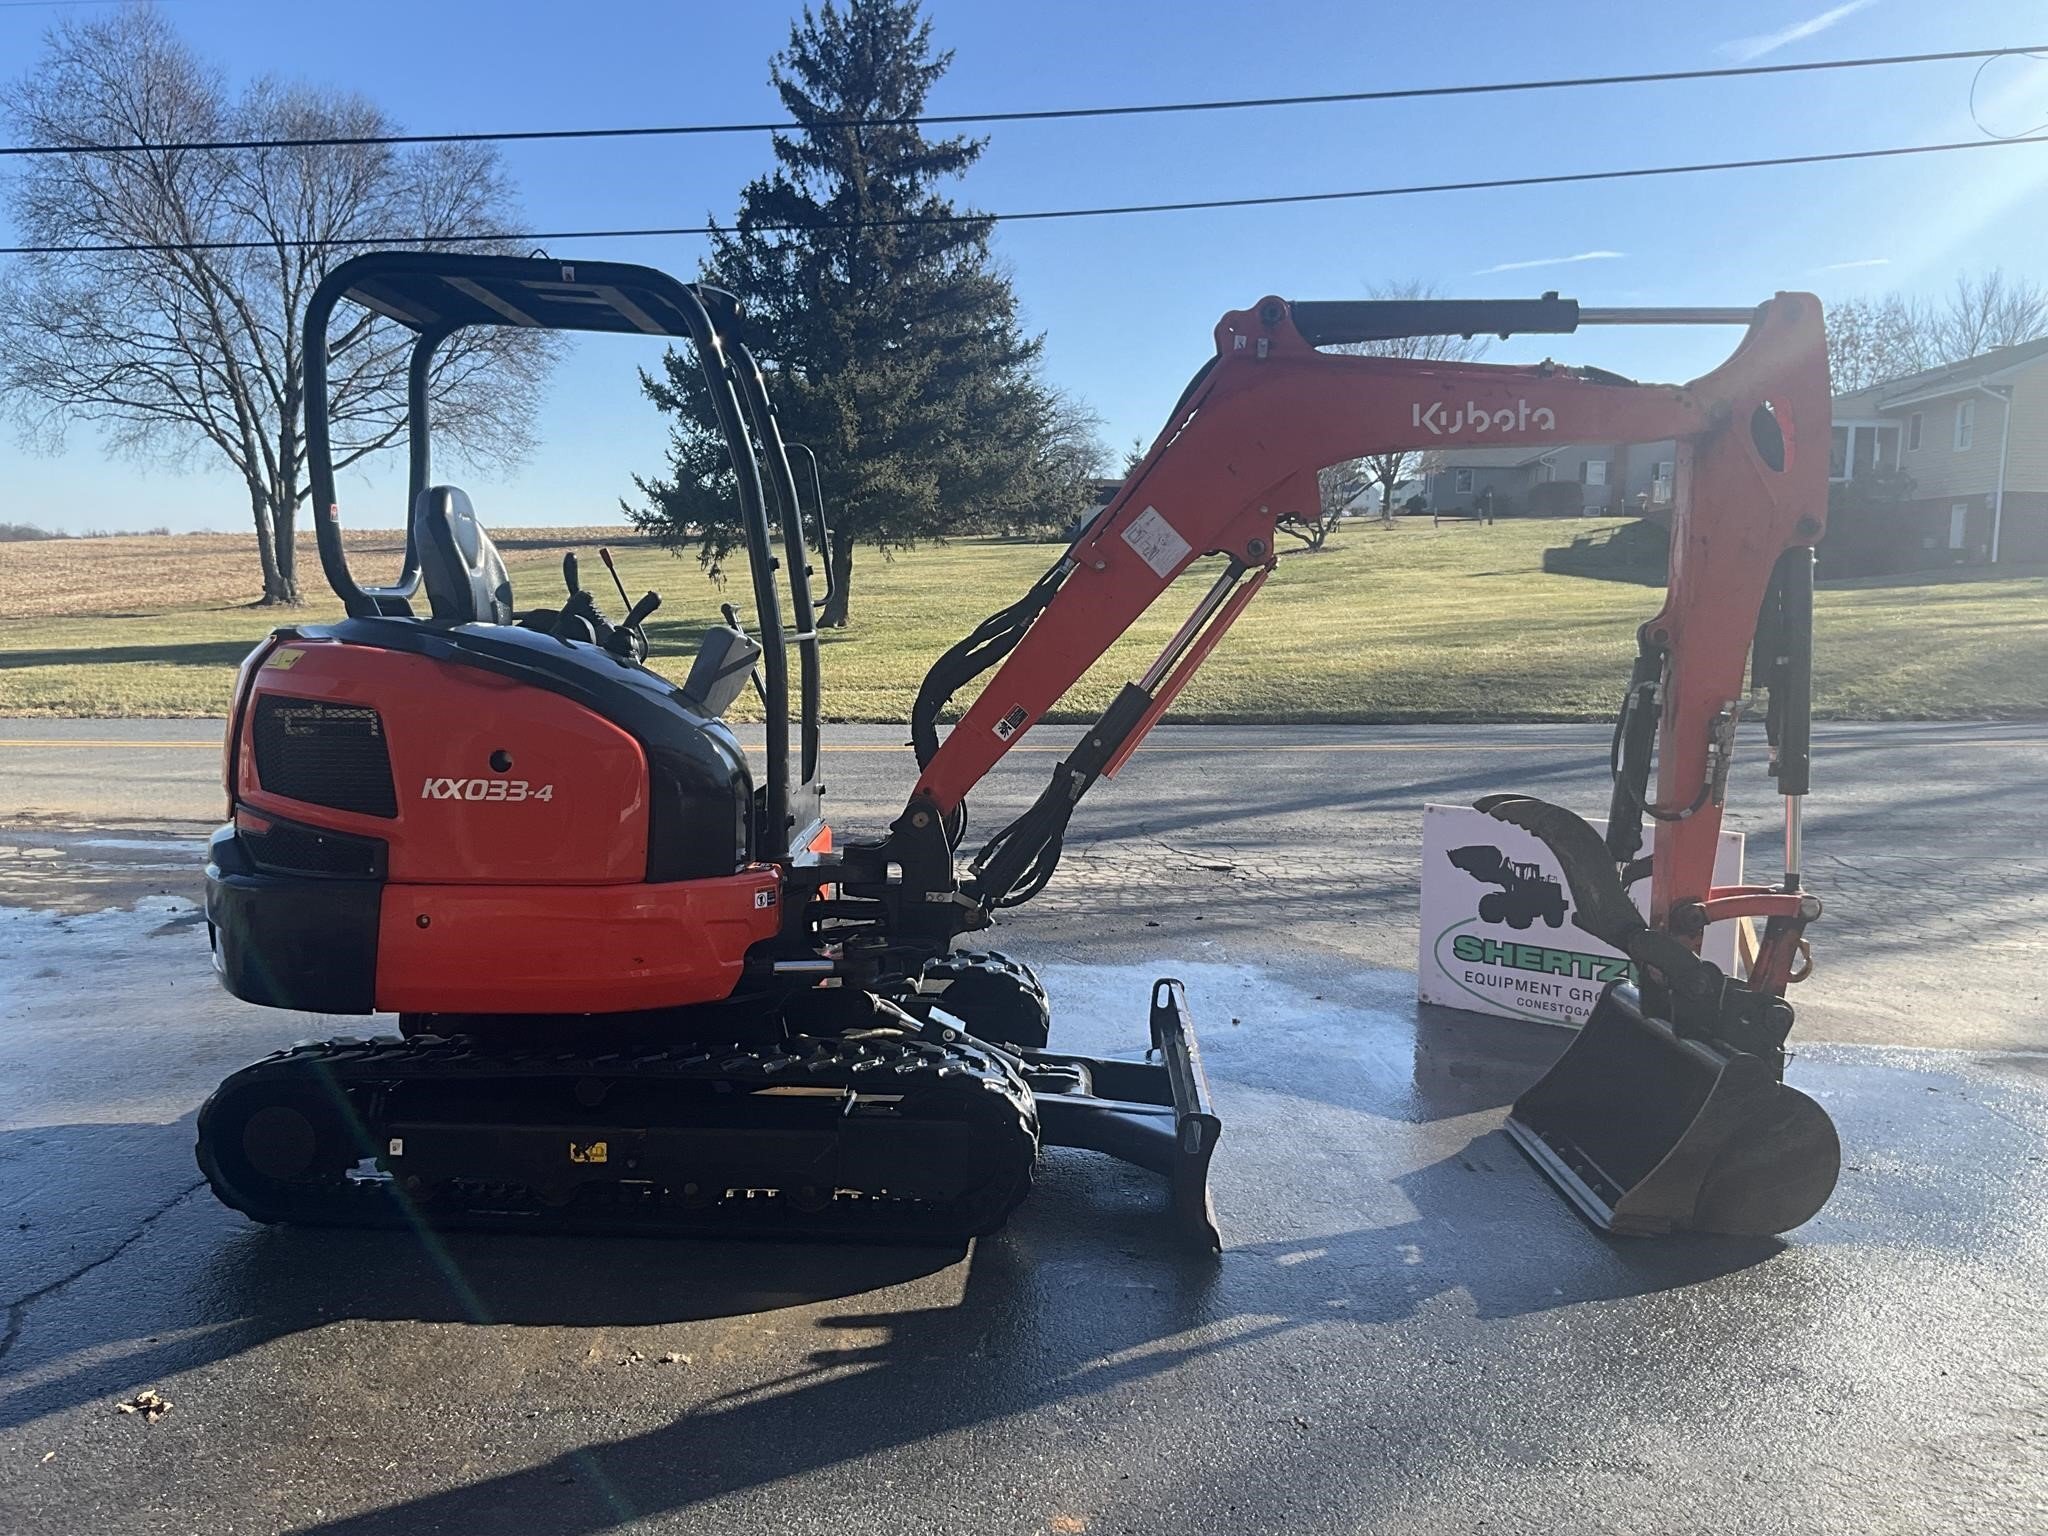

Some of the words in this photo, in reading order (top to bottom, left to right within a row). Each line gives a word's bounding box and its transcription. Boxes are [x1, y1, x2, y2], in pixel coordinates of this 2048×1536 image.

[1412, 399, 1555, 435] Kubota
[421, 778, 553, 802] KX033-4
[1464, 970, 1563, 998] EQUIPMENT
[1516, 997, 1590, 1017] CONESTOGA
